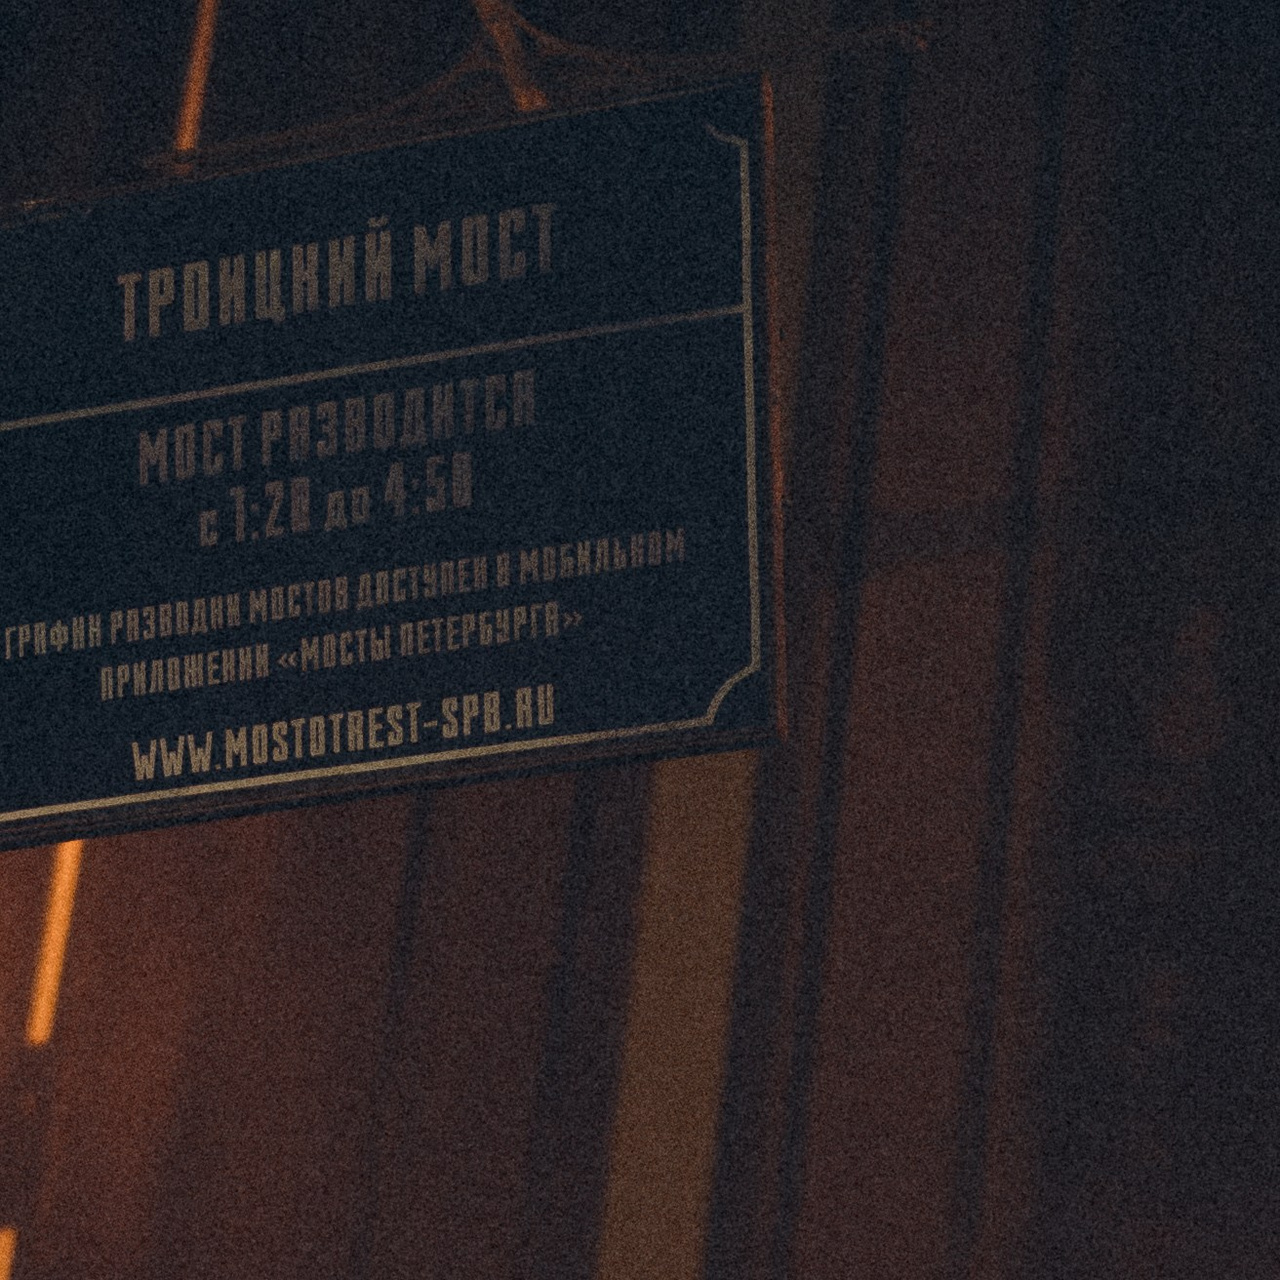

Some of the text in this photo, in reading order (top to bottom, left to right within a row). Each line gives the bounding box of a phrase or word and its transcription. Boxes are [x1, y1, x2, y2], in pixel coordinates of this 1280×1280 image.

[116, 202, 558, 342] ТРОИЦКИЙ МОСТ
[138, 368, 535, 487] МОСТ РАЗВОДИТСЯ
[228, 475, 312, 543] 1:20
[323, 485, 371, 533] до
[384, 451, 472, 517] 4:50
[4, 526, 686, 661] ГРАФИК РАЗВОДКИ МОСТОВ ДОСТУПЕН В МОБИЛЬНОМ
[99, 600, 584, 701] ПРИЛОЖЕНИИ «МОСТЫ ПЕТЕРБУРГА»
[131, 683, 556, 782] WWW.MOSTOTREST-SPB.RU
